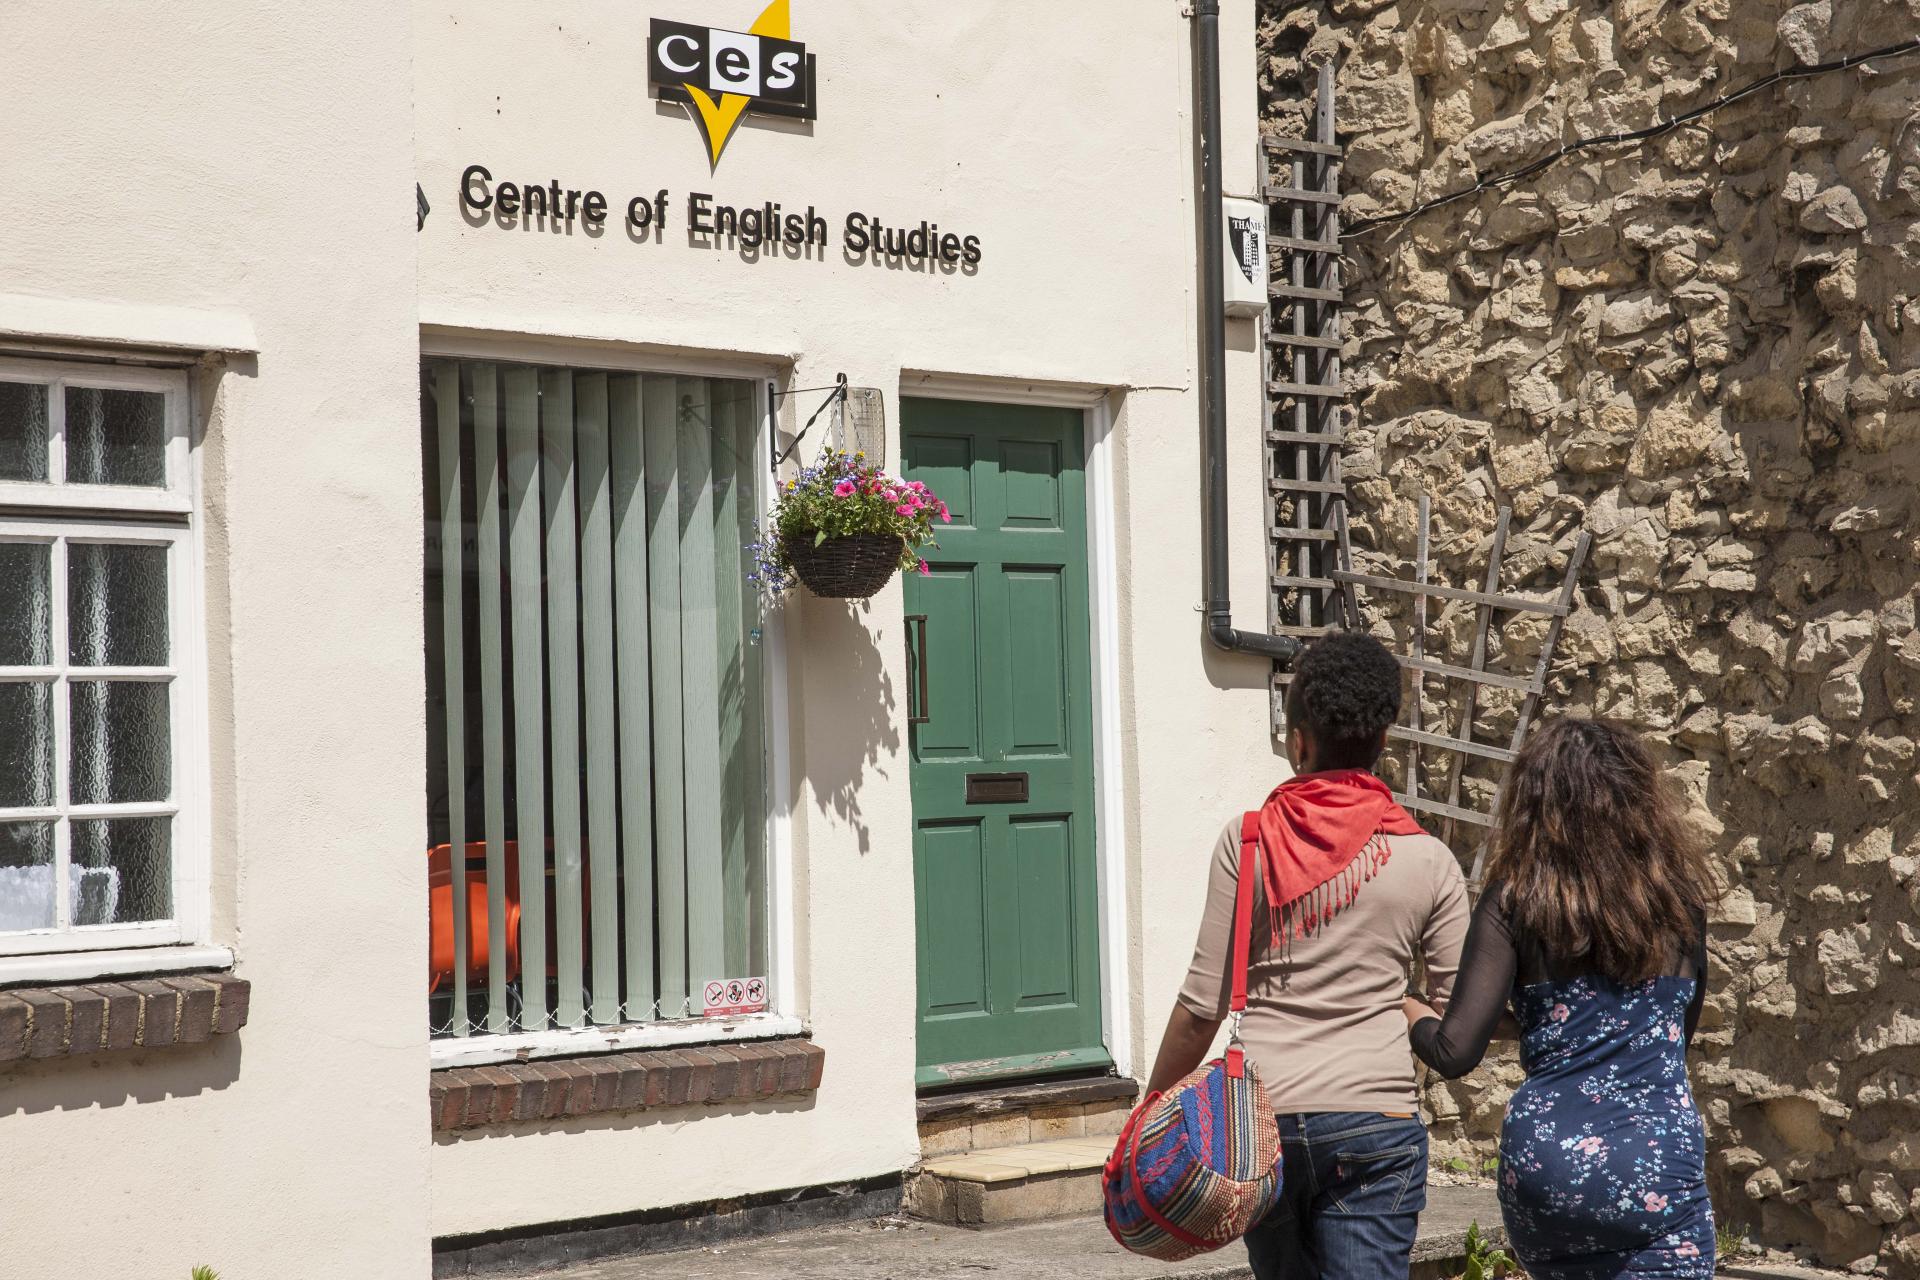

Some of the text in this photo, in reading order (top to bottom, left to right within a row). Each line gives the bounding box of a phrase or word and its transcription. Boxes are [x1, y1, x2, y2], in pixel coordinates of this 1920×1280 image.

[657, 34, 800, 89] ces
[461, 165, 982, 264] Centre of English Studies
